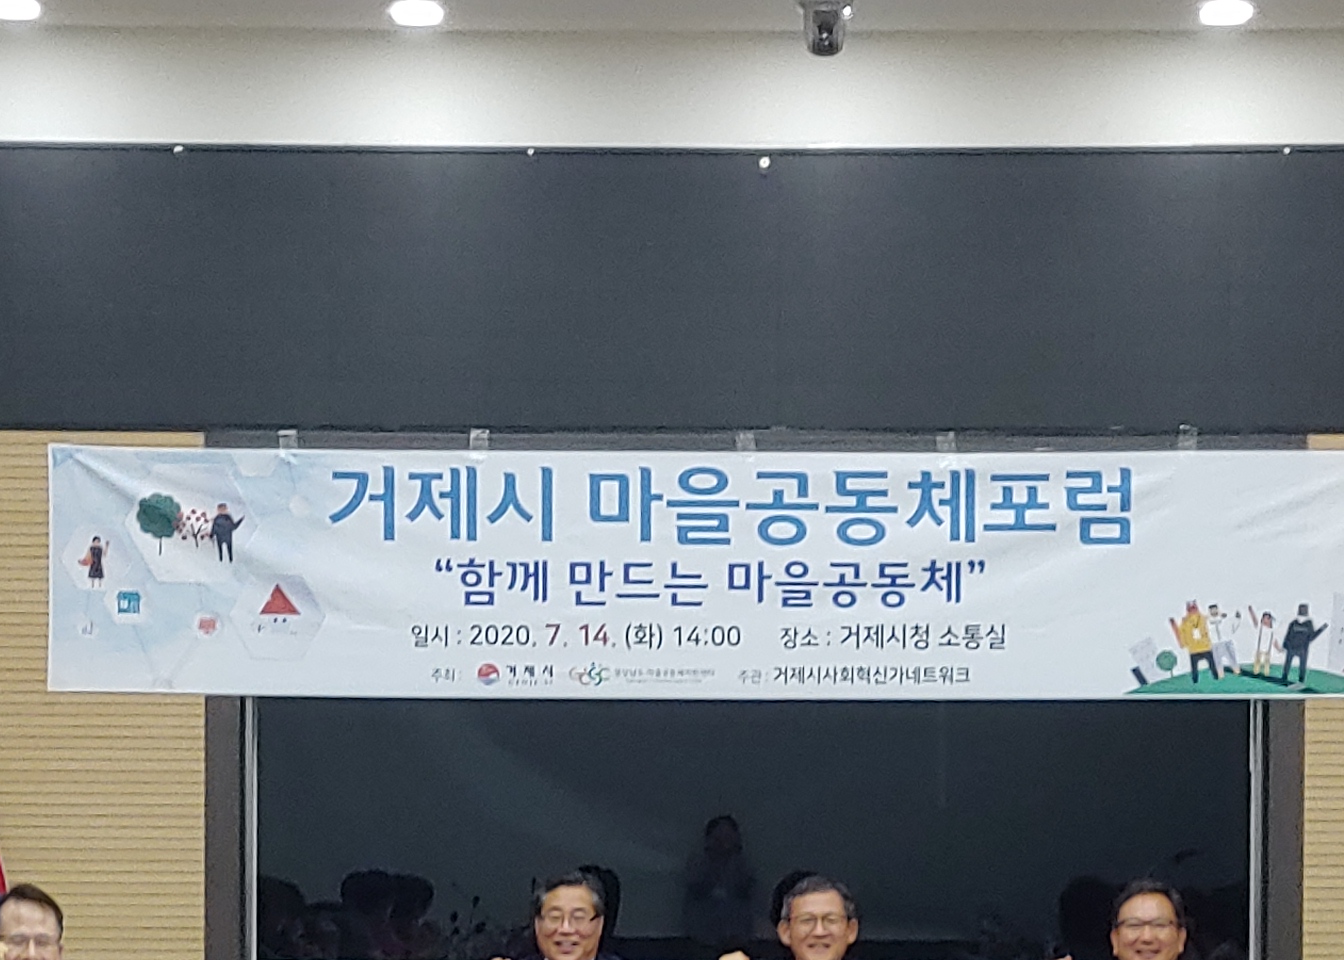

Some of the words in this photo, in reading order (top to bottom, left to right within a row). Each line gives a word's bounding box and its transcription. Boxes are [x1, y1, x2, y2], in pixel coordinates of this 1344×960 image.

[329, 466, 553, 542] 거제시
[589, 466, 1132, 546] 마을공동체포럼
[568, 559, 709, 607] 만드는
[411, 623, 450, 648] 일시
[469, 624, 537, 648] 2020.
[544, 623, 568, 648] 7.
[578, 623, 617, 648] 14.
[625, 622, 664, 650] (화)
[672, 624, 742, 648] 14:00
[780, 625, 820, 650] 장소
[840, 622, 931, 651] 거제시청
[937, 622, 1008, 651] 소통실
[773, 665, 972, 686] 거제시사회혁신가네트워크
